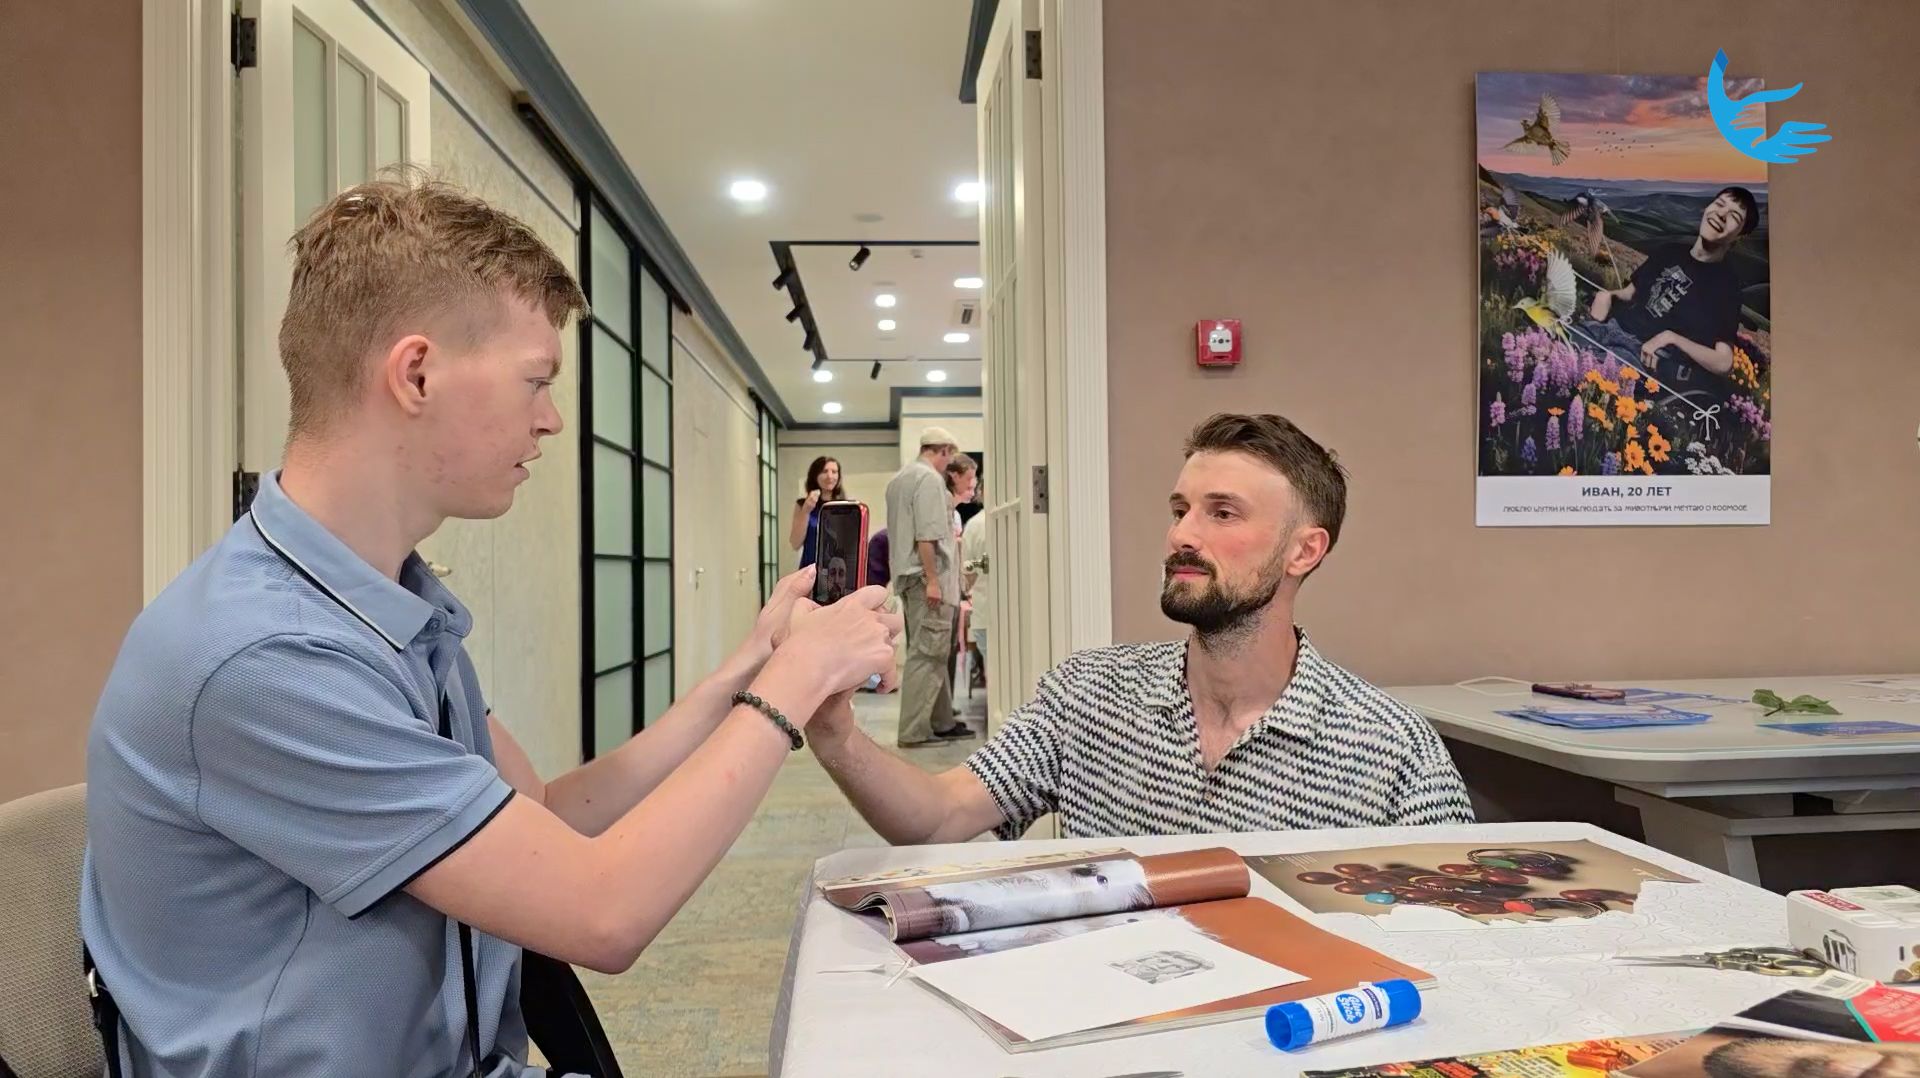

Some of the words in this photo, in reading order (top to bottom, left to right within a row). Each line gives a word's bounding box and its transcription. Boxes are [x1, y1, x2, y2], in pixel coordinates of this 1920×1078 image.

[1581, 486, 1624, 498] ИВАН,
[1627, 486, 1643, 497] 20
[1646, 486, 1673, 497] ЛЕТ
[1347, 996, 1363, 1018] Glue
